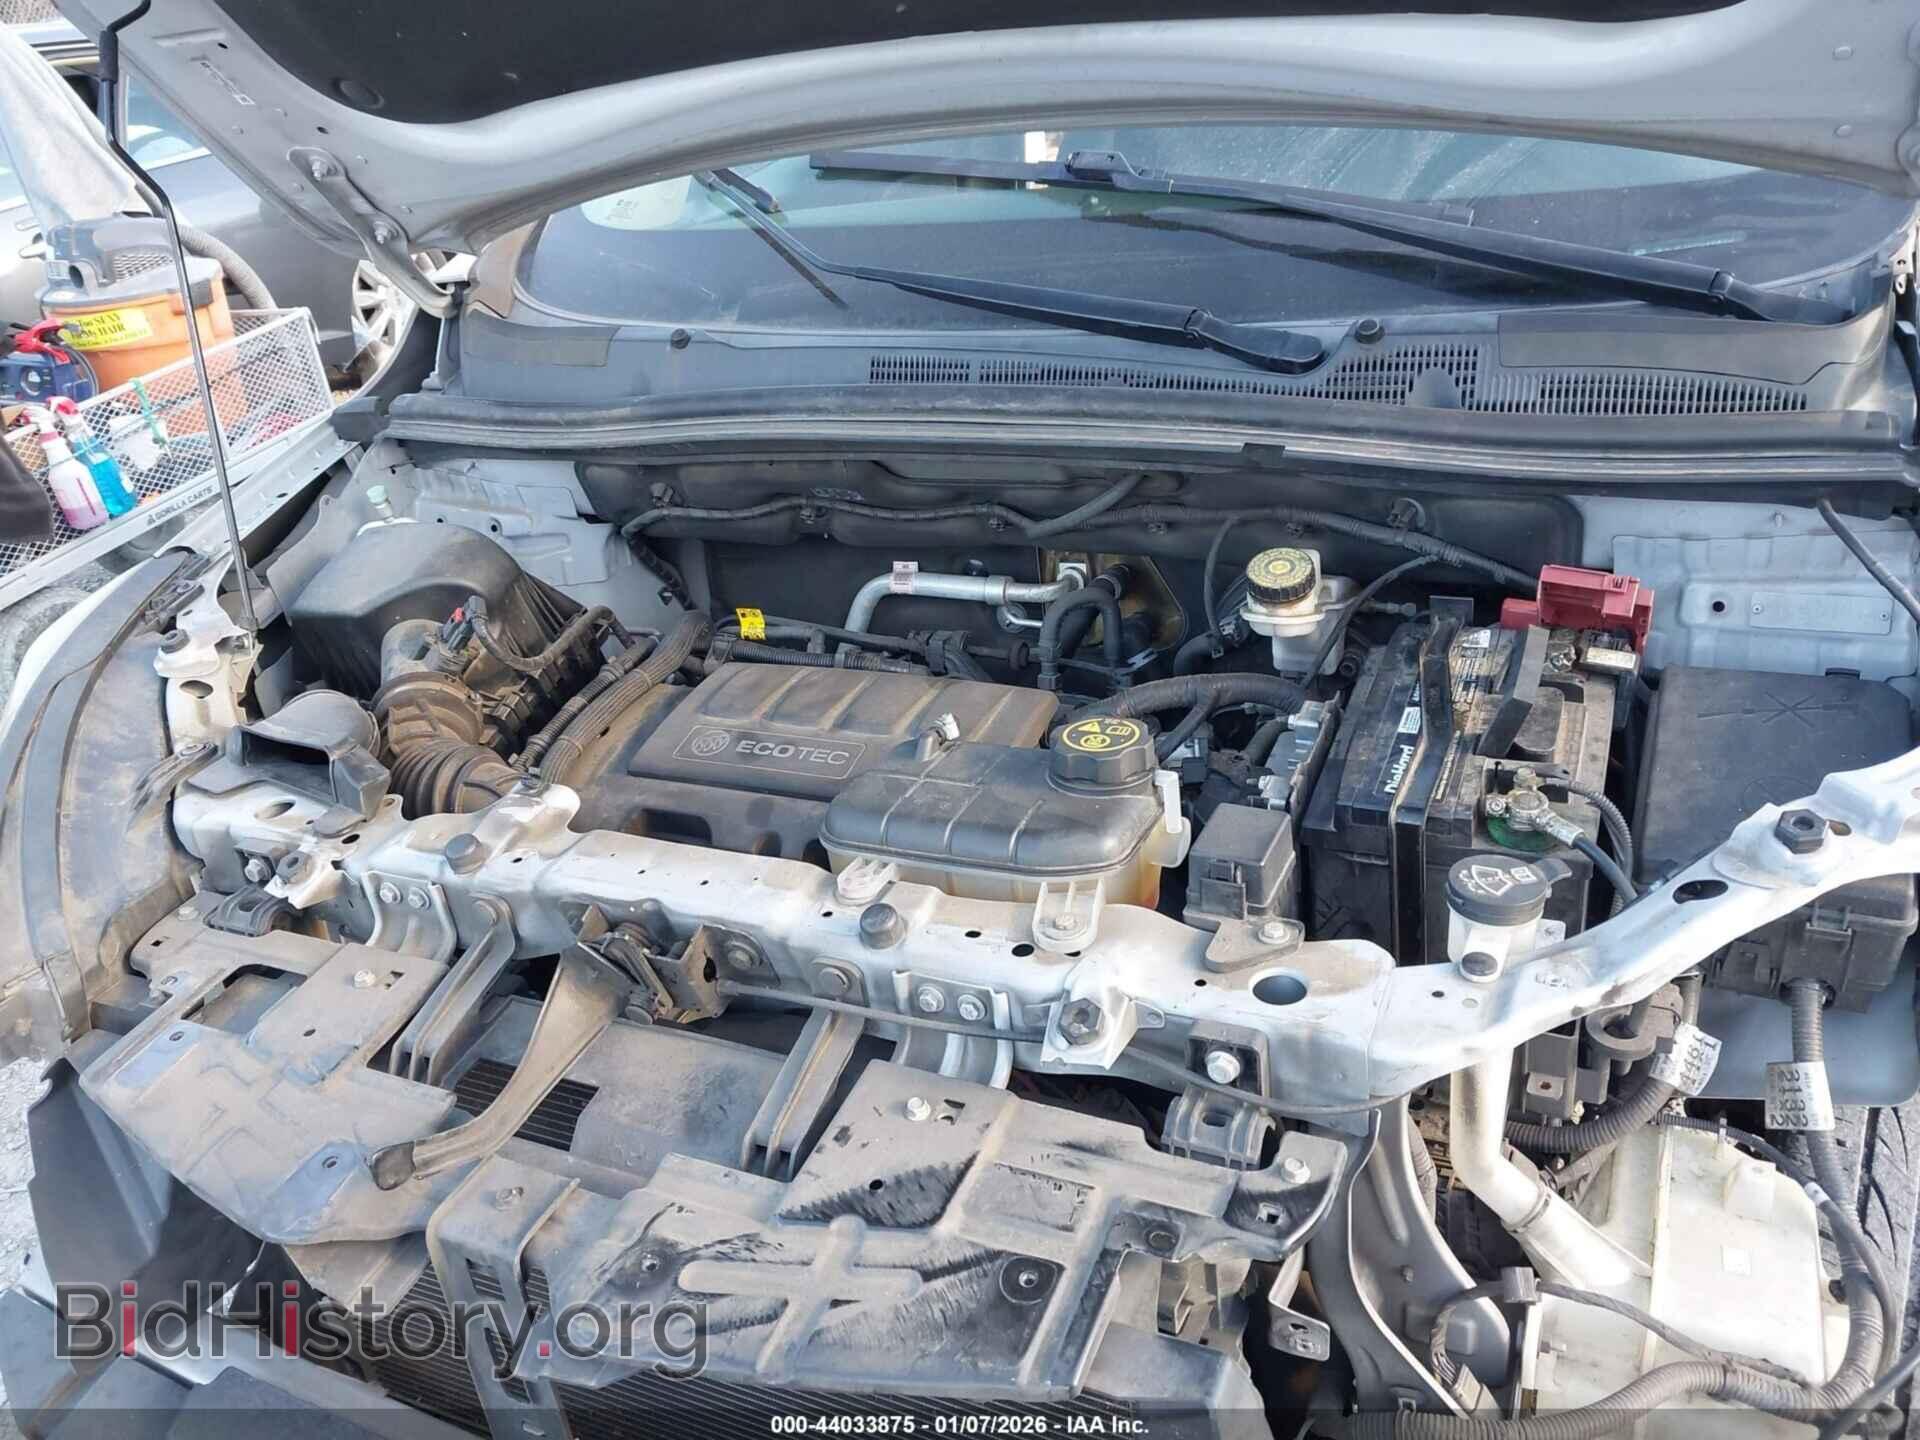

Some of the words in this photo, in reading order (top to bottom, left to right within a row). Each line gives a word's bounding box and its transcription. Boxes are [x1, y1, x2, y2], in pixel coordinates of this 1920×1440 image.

[153, 500, 188, 521] GORILLA
[187, 485, 213, 503] CARTS
[735, 739, 850, 766] ECOTEC
[1383, 744, 1415, 794] DieHard
